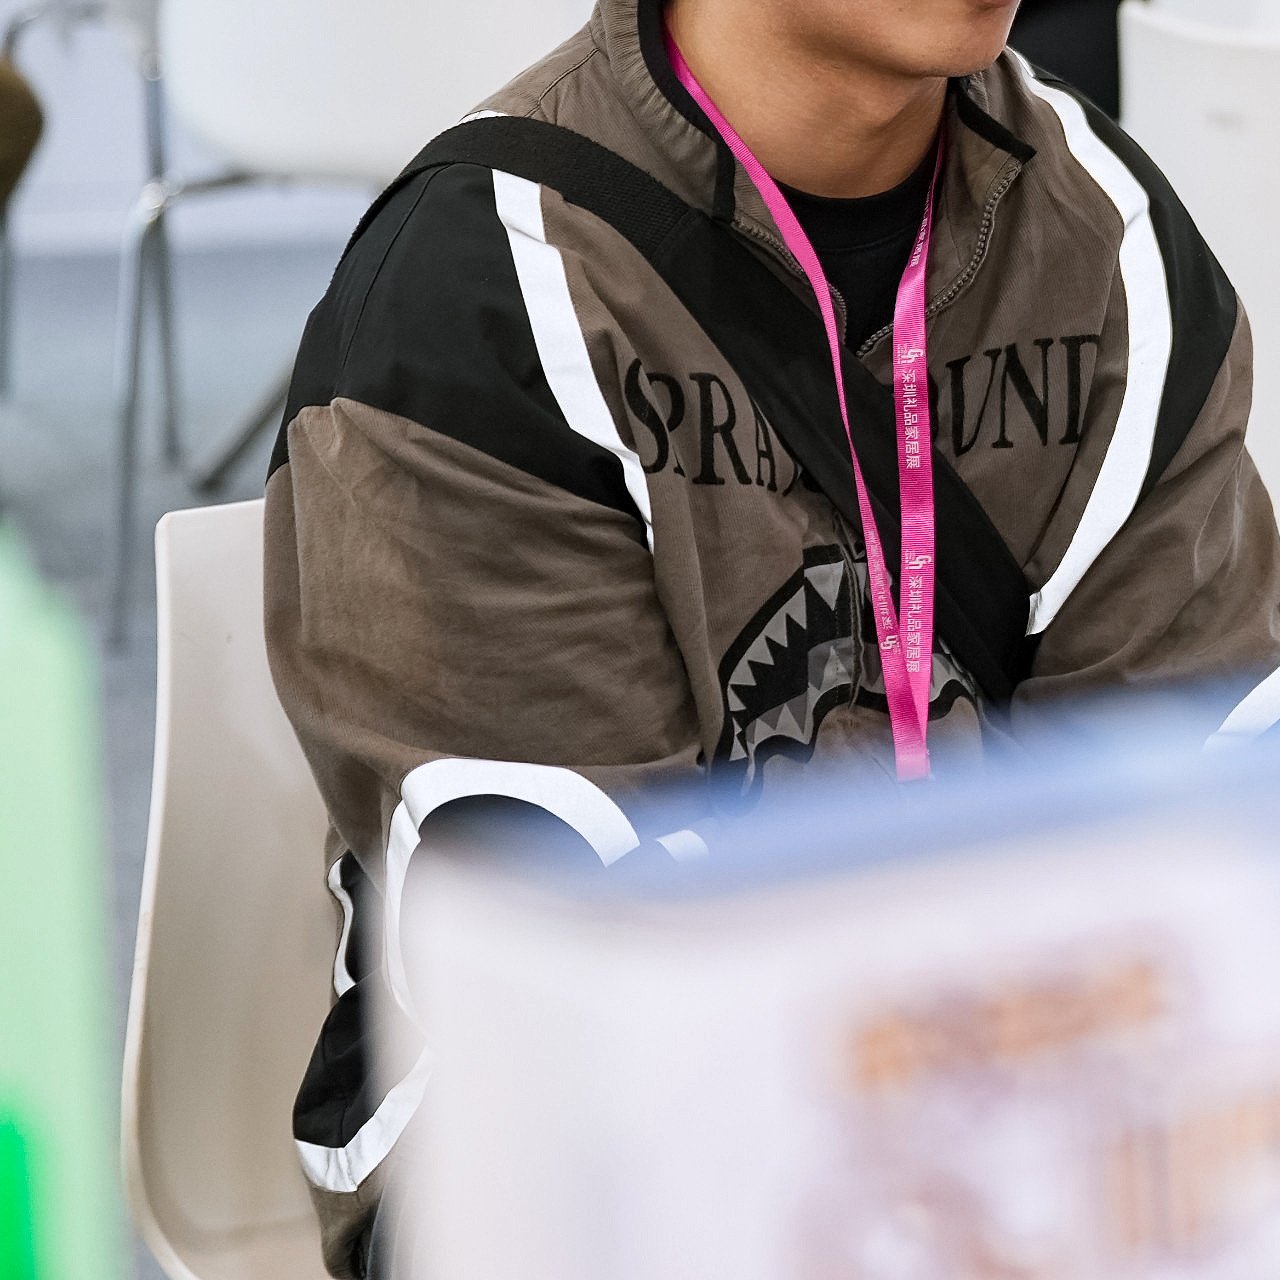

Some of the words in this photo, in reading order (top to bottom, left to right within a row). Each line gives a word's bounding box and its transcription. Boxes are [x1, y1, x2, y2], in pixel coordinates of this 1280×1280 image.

[901, 369, 921, 470] 深圳礼品家居展
[906, 575, 923, 673] 深圳礼品家居展
